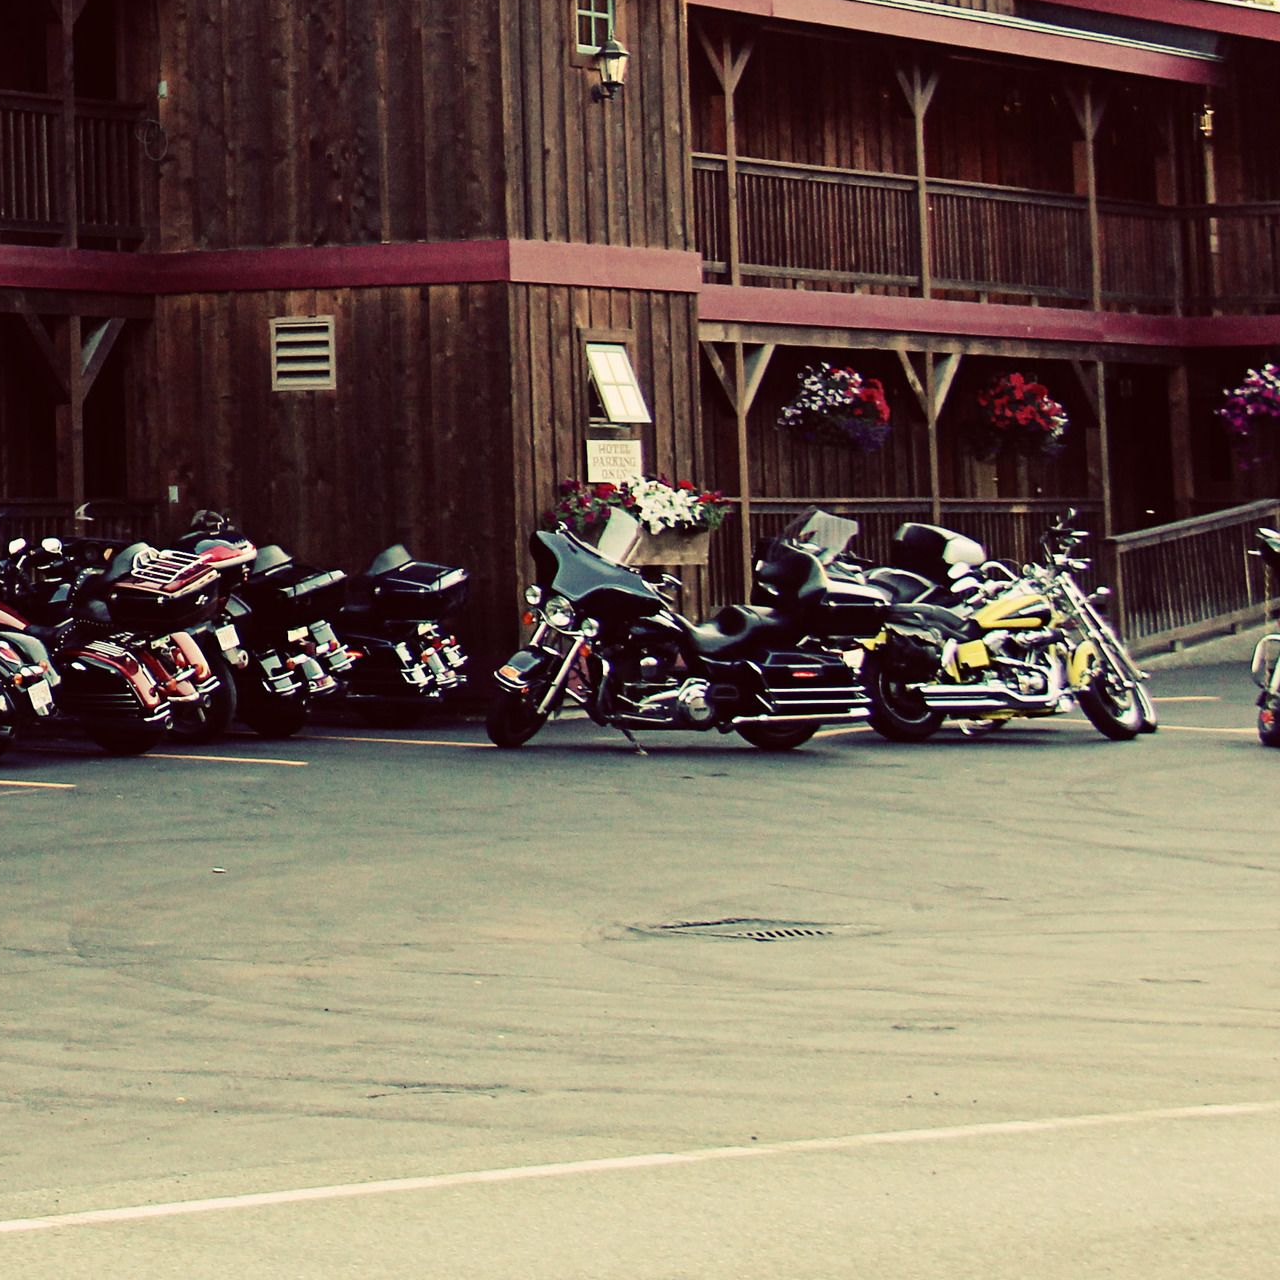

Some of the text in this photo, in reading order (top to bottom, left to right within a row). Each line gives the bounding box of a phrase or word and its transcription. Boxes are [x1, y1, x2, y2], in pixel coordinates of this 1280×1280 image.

[598, 443, 631, 454] HOTEL
[592, 456, 637, 467] PARKING
[601, 468, 630, 480] ONLY
